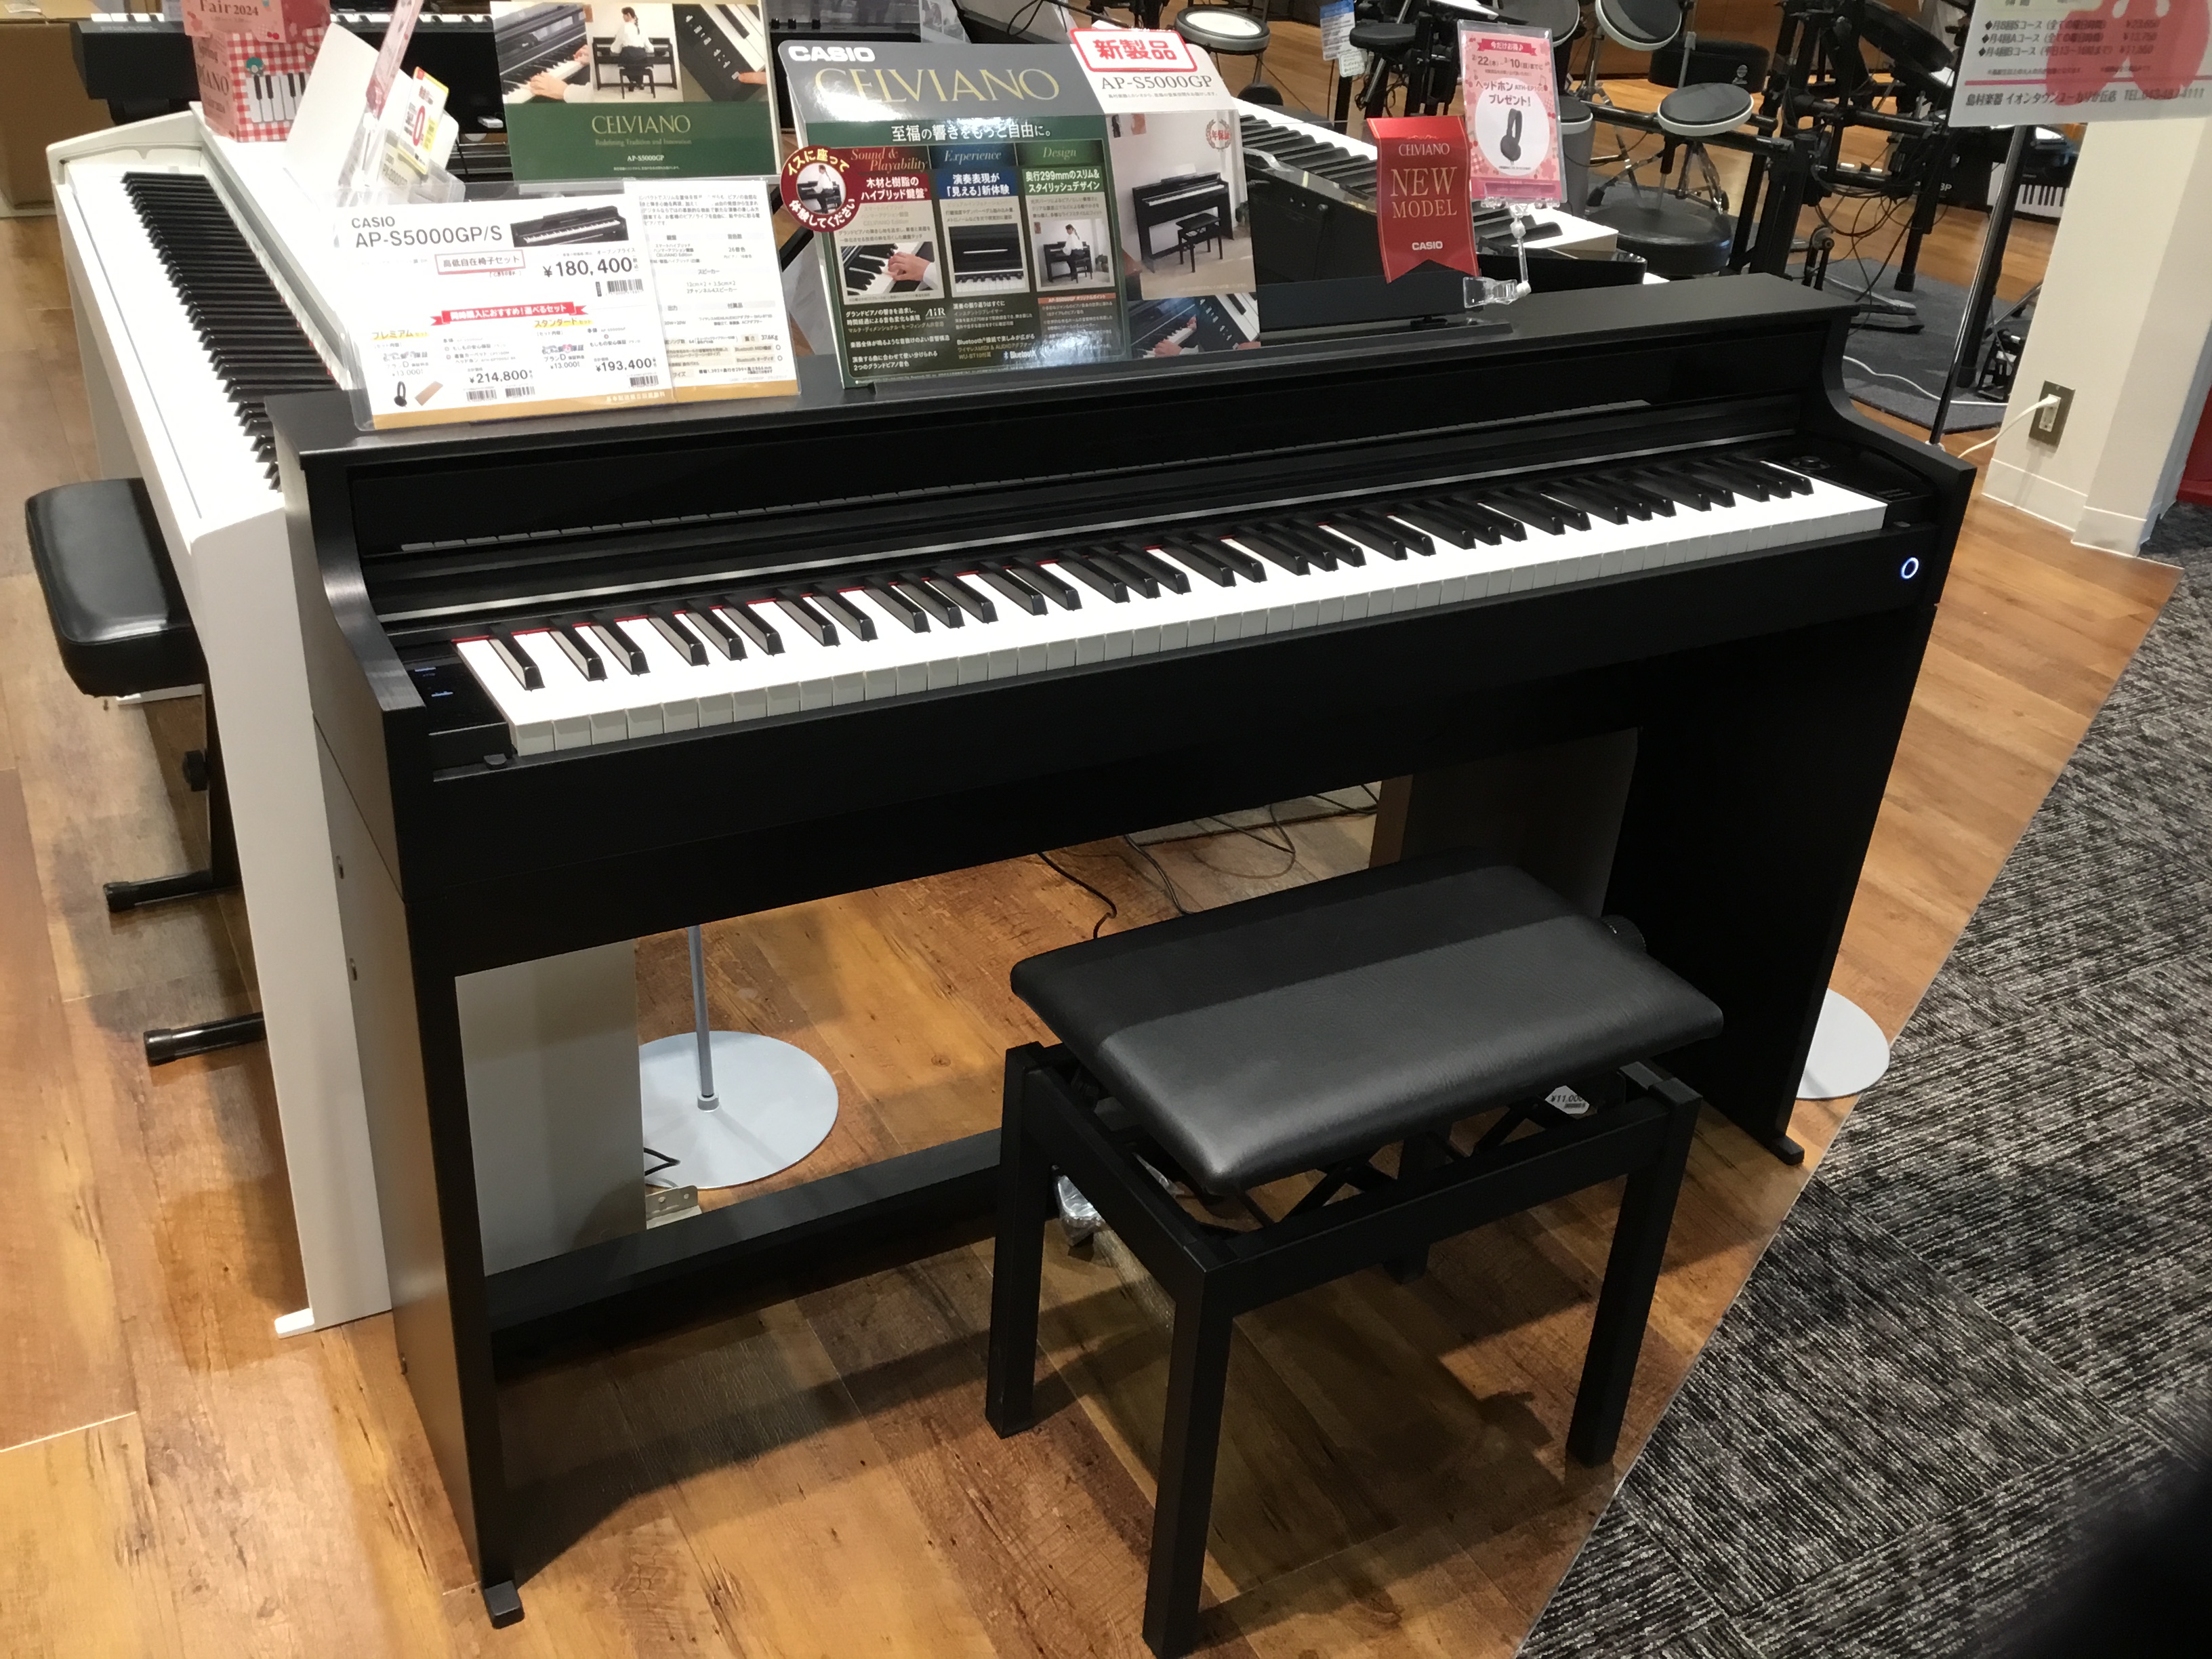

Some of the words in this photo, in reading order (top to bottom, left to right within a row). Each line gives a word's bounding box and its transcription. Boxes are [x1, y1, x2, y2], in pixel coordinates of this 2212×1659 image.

[234, 5, 259, 16] 2024
[788, 46, 876, 62] CASIO
[1092, 39, 1177, 60] 新製品
[815, 68, 1060, 102] CELVIANO
[1101, 75, 1213, 89] AP-S5000GP
[1475, 80, 1513, 92] ヘッドホン
[1488, 94, 1532, 107] プレゼント!
[1965, 92, 2003, 106] 島村楽器
[591, 115, 691, 135] CELVIANO
[890, 123, 1052, 143] 至福の響きをもっと自由に。
[851, 148, 885, 161] Sound
[888, 148, 899, 159] &
[1042, 146, 1077, 160] Design
[1398, 142, 1450, 157] CELVIANO
[787, 148, 851, 176] イスに座って
[944, 150, 1002, 165] Experience
[870, 158, 928, 174] Playability
[866, 176, 920, 189] 木材と樹脂の
[952, 173, 1000, 185] 演奏表現が
[1025, 169, 1101, 182] 奥行299mmのスリム&
[1390, 166, 1458, 197] NEW
[946, 184, 1010, 198] 「見える」新体験
[1028, 181, 1101, 193] スタイリッシュデザイン
[788, 198, 856, 228] 体験してください
[1392, 199, 1458, 219] MODEL
[351, 216, 395, 229] CASIO
[355, 225, 503, 249] AP-S5000GP/S
[1412, 241, 1443, 251] CASIO
[443, 255, 520, 268] 高低自在椅子セット
[542, 257, 632, 278] ¥180,400
[596, 358, 652, 373] ¥193,400
[470, 369, 529, 384] ¥214,800
